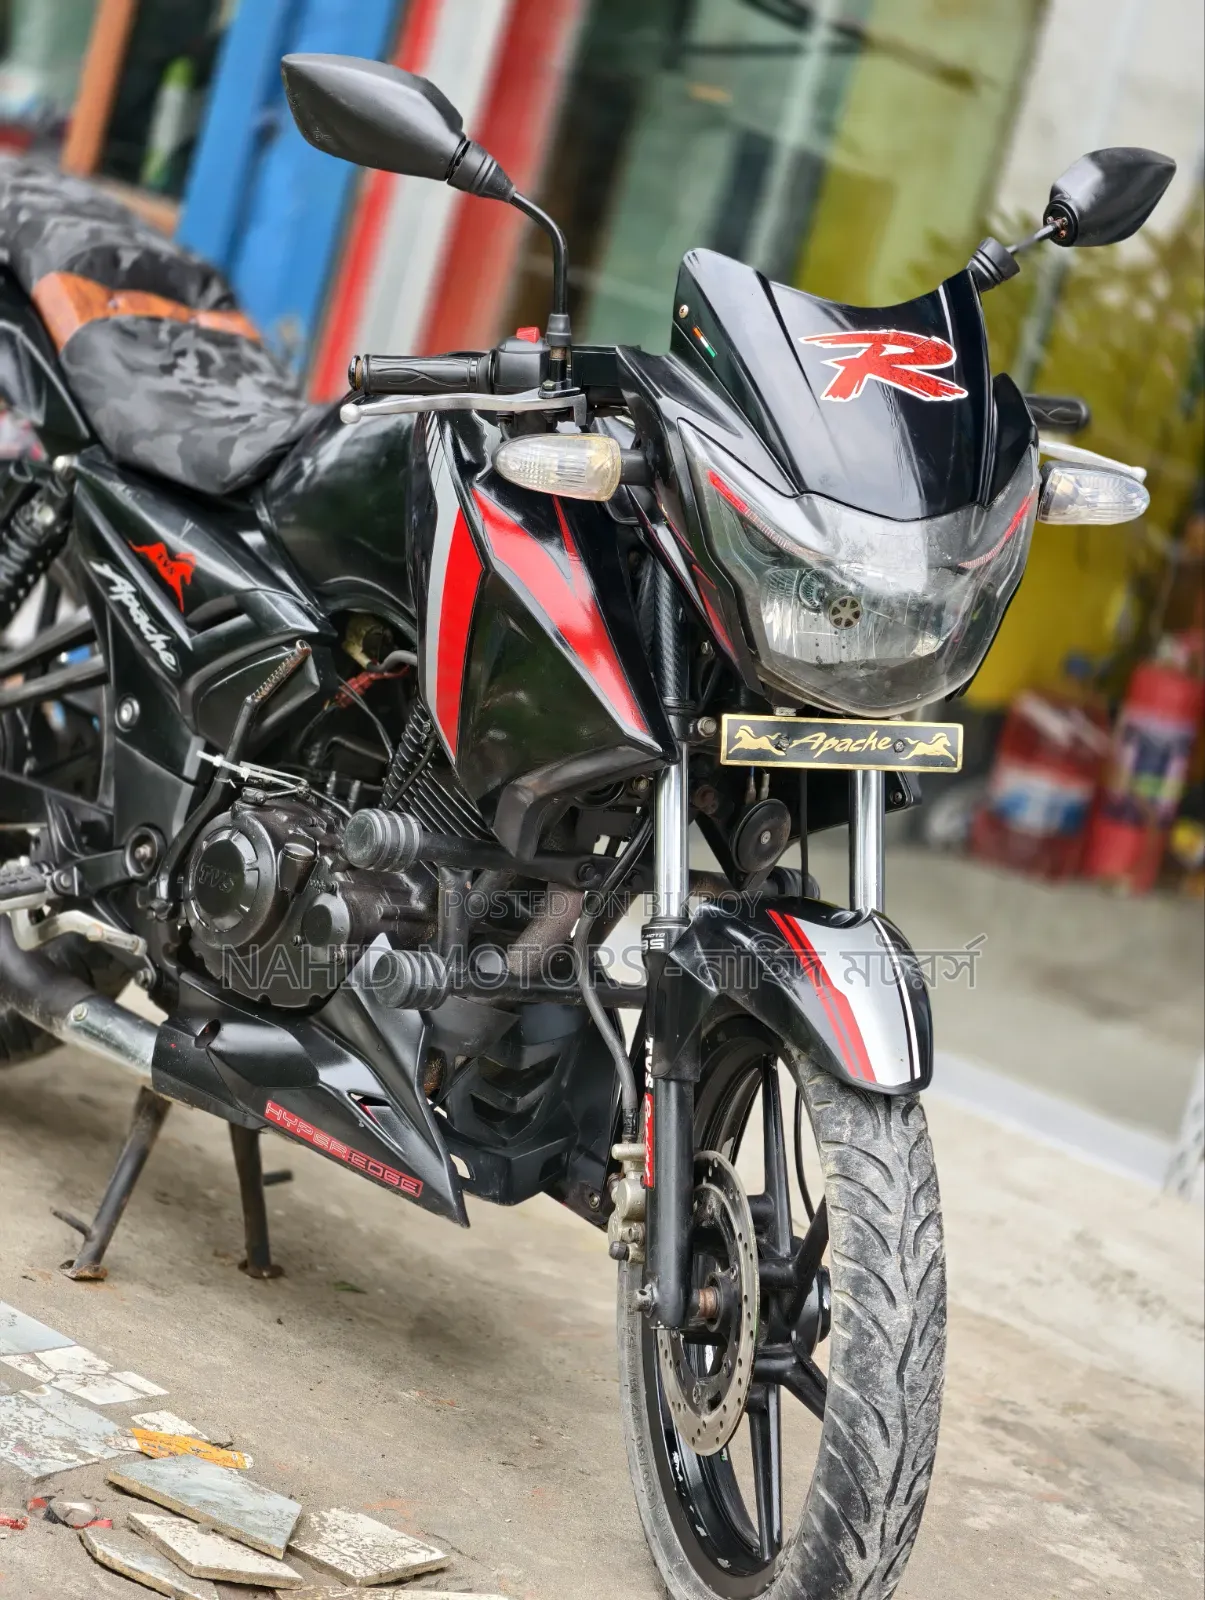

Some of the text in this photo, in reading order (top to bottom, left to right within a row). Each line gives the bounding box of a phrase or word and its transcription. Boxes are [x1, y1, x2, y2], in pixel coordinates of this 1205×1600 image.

[797, 328, 969, 402] R
[89, 560, 178, 672] Apache
[791, 730, 892, 760] Apache
[199, 862, 234, 893] TVS
[265, 1101, 418, 1195] HYPER EDGE
